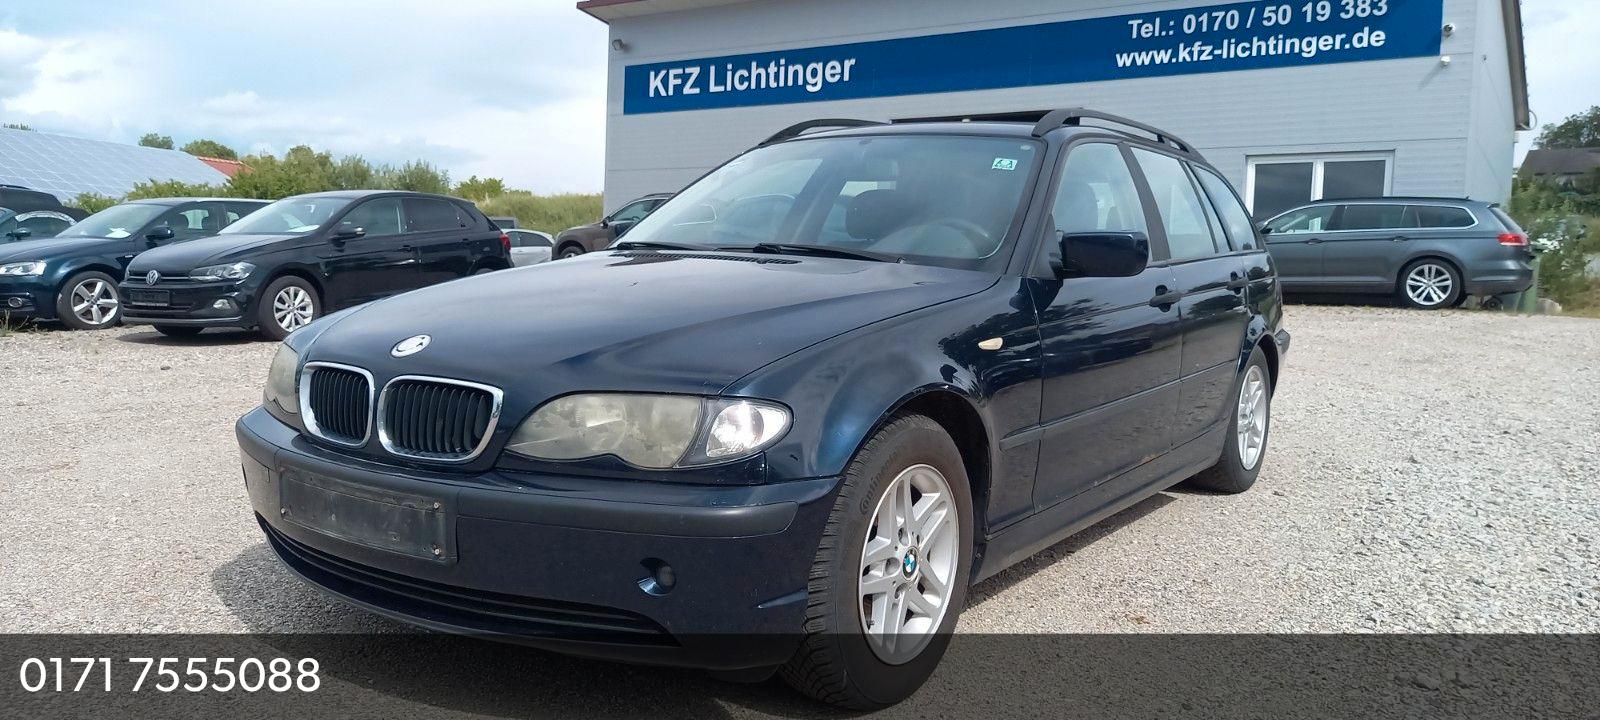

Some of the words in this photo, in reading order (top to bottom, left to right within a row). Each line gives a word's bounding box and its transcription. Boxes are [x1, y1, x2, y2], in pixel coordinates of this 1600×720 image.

[1128, 19, 1175, 39] Tel.:
[1182, 10, 1240, 34] 0170
[1246, 8, 1256, 28] /
[1262, 5, 1292, 27] 50
[1301, 1, 1331, 23] 19
[1339, 0, 1388, 19] 383
[1115, 26, 1386, 67] www.kfz-lichtinger.de
[649, 66, 701, 97] KFZ
[709, 57, 856, 93] Lichtinger
